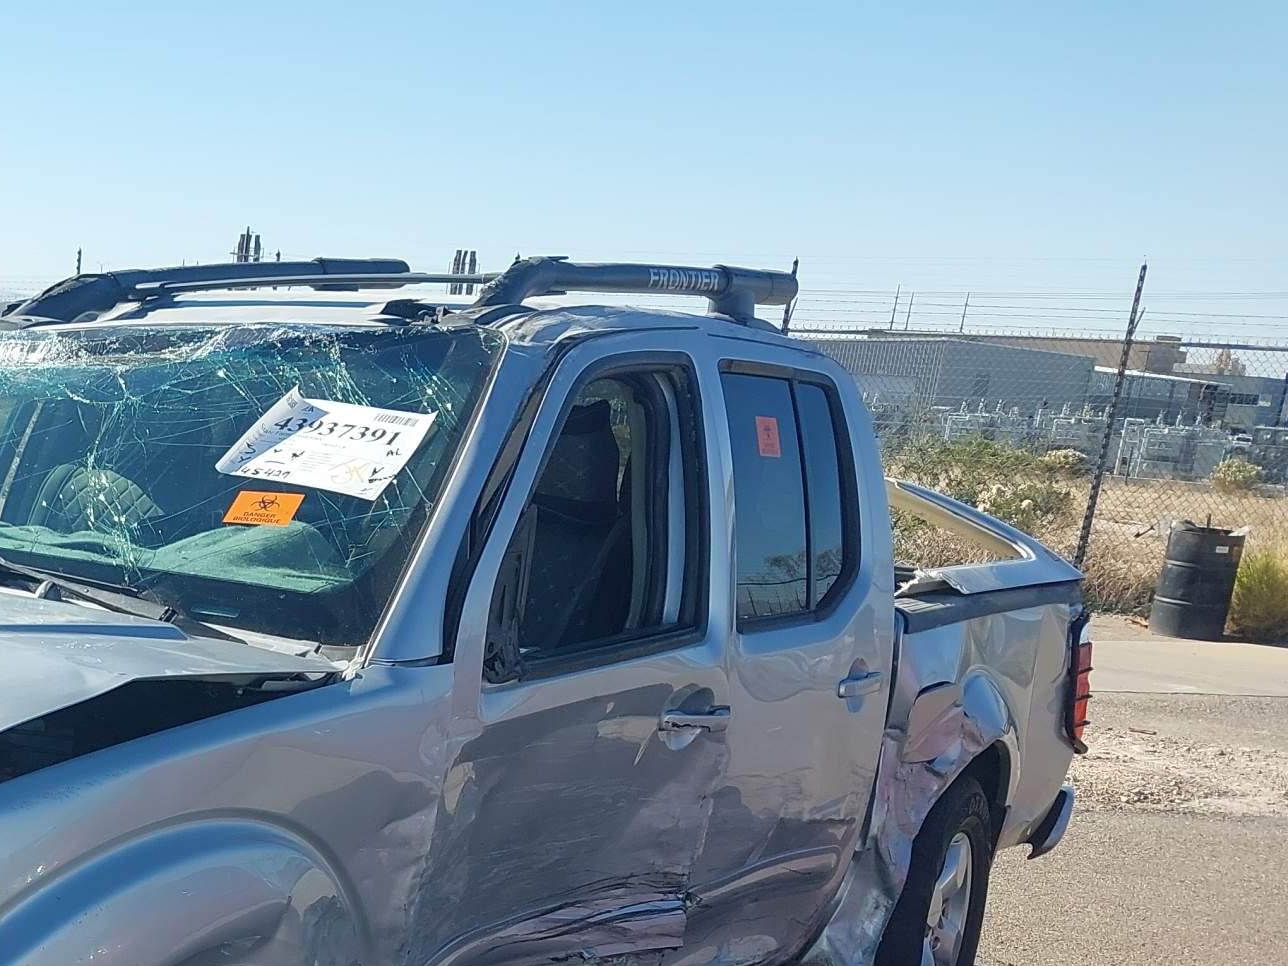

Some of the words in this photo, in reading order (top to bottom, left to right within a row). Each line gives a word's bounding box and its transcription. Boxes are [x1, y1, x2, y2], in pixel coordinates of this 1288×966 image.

[648, 268, 720, 291] FRONTIER
[274, 417, 402, 446] 43937391
[243, 511, 278, 519] DANGER
